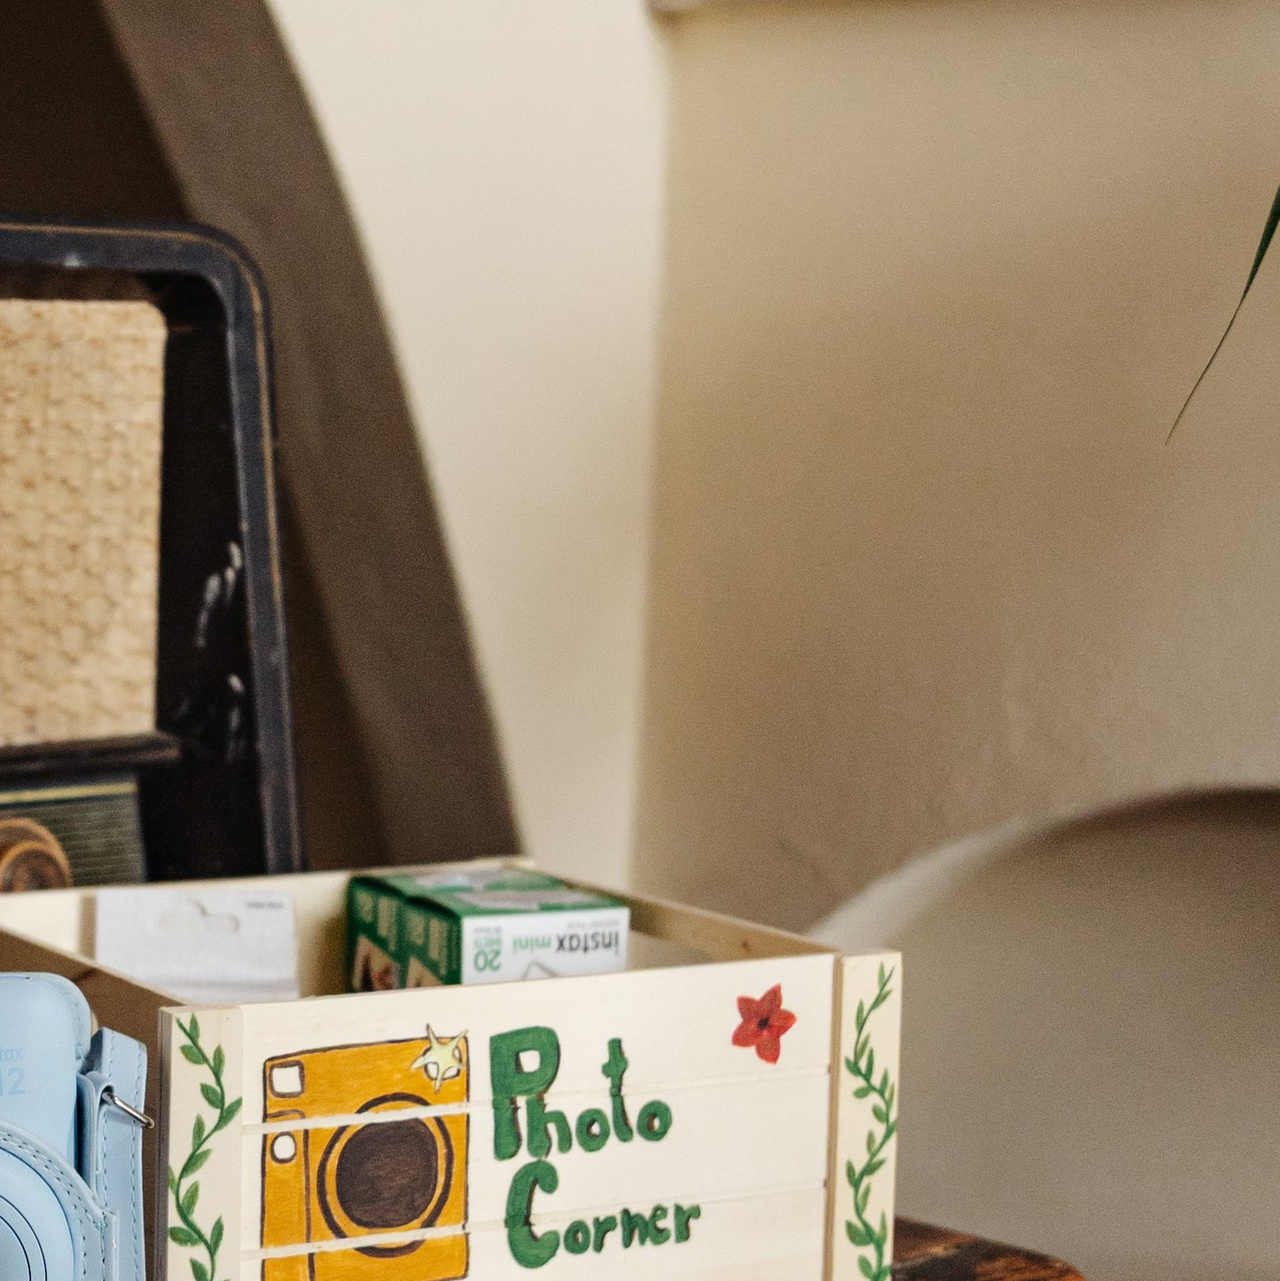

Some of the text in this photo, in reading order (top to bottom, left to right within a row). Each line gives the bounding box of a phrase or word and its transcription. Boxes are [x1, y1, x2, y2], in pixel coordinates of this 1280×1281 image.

[473, 949, 502, 972] 20
[512, 931, 620, 956] instax mini
[489, 1026, 673, 1161] Photo
[504, 1159, 701, 1268] Corner
